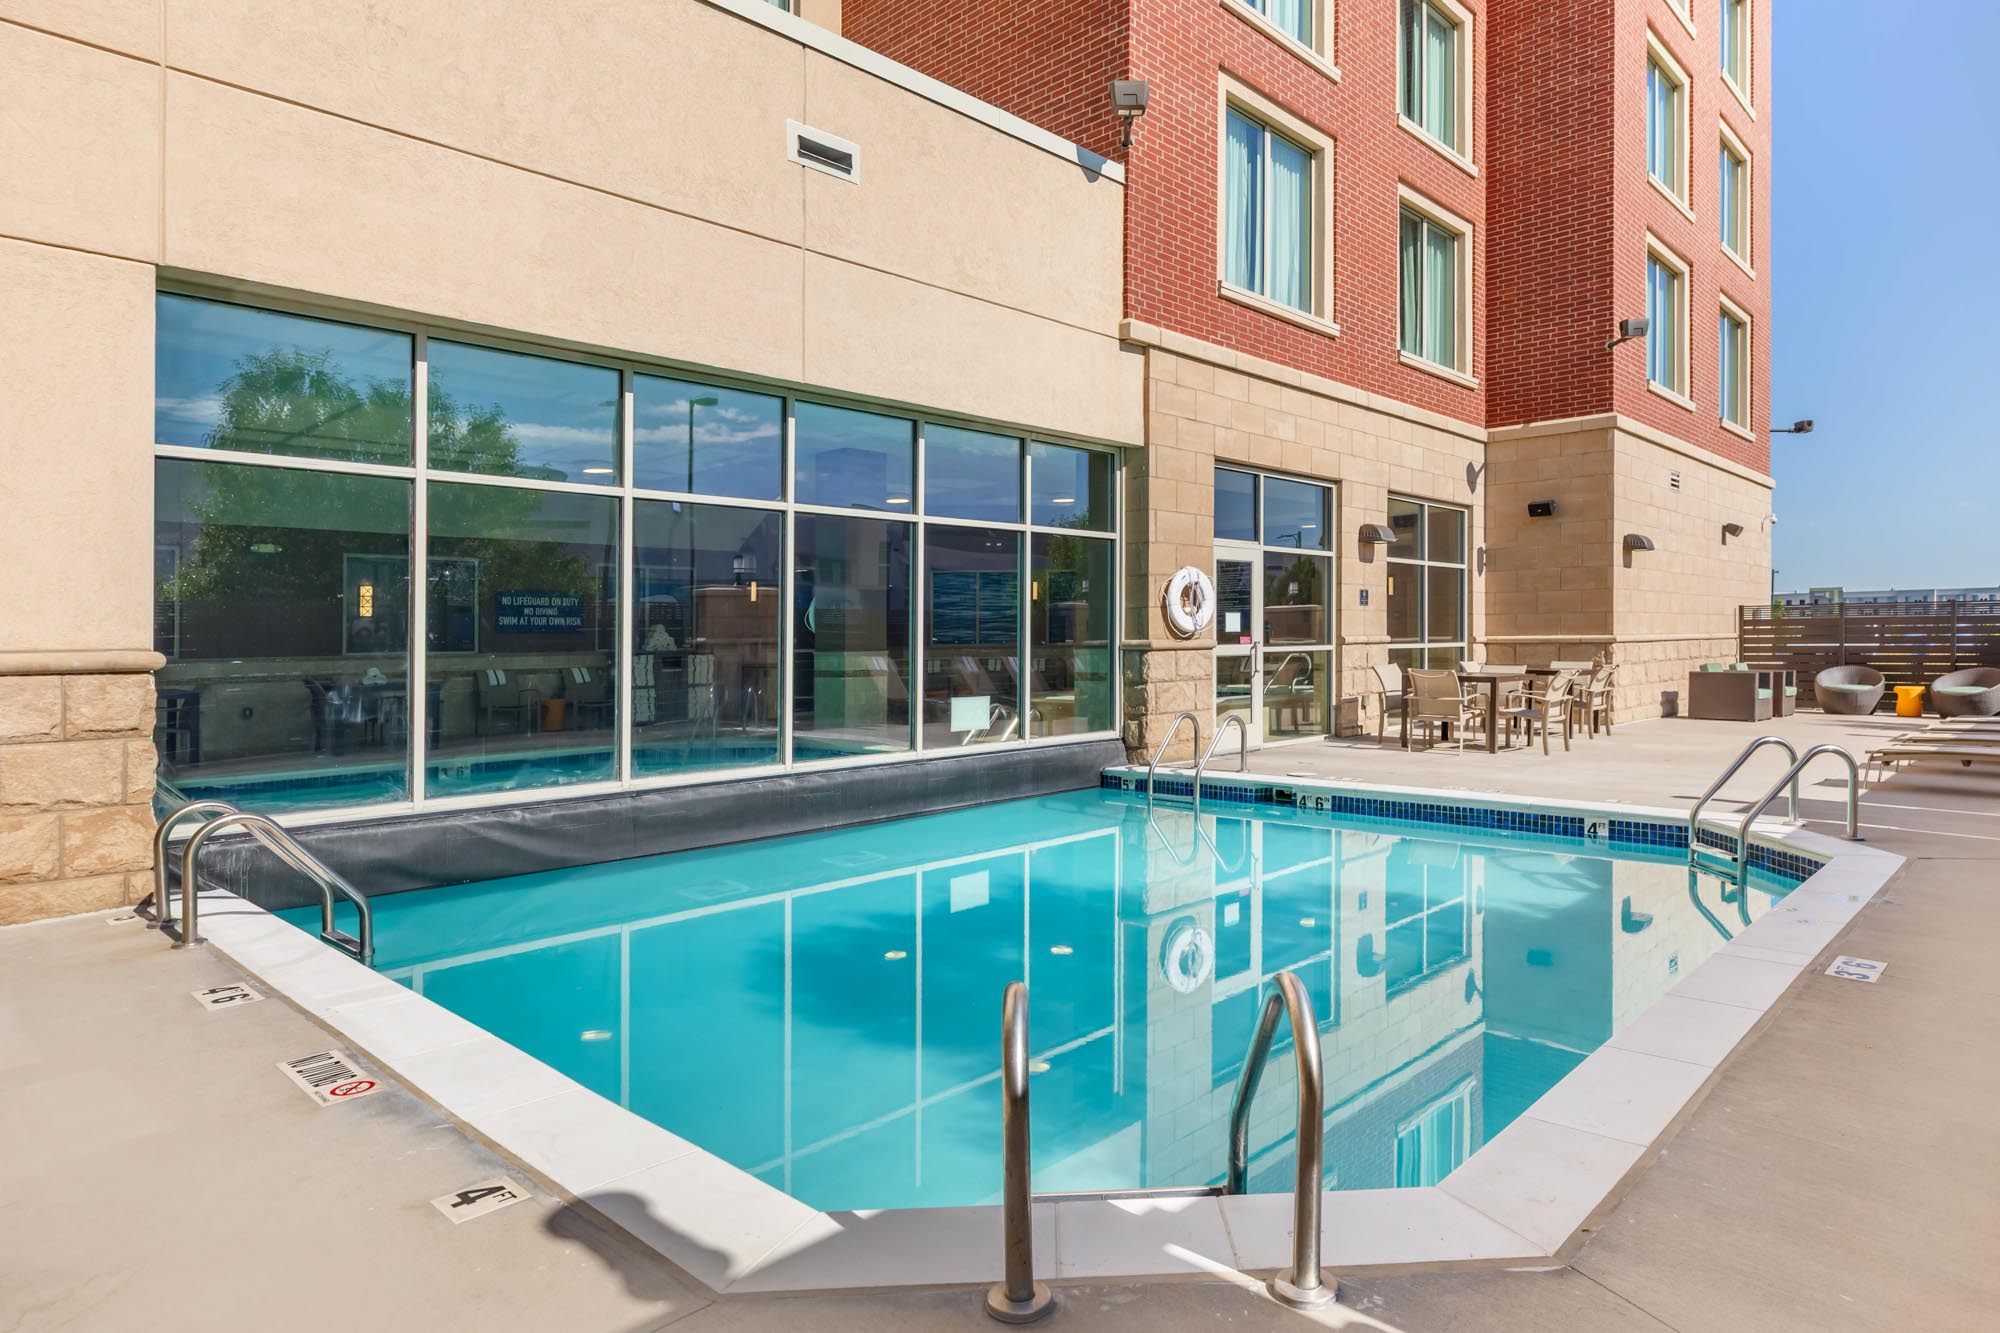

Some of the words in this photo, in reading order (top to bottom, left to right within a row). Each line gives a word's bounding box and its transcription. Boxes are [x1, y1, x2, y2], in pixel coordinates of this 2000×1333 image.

[502, 597, 512, 606] NO
[513, 597, 550, 606] LIFEGUARD
[551, 597, 561, 606] ON
[562, 597, 579, 607] DUTY
[524, 608, 534, 616] NO
[535, 608, 558, 616] DIVING
[498, 616, 518, 625] SWIM
[519, 616, 528, 625] AT
[530, 616, 547, 625] YOUR
[549, 616, 565, 625] OWN
[566, 616, 582, 625] RISK
